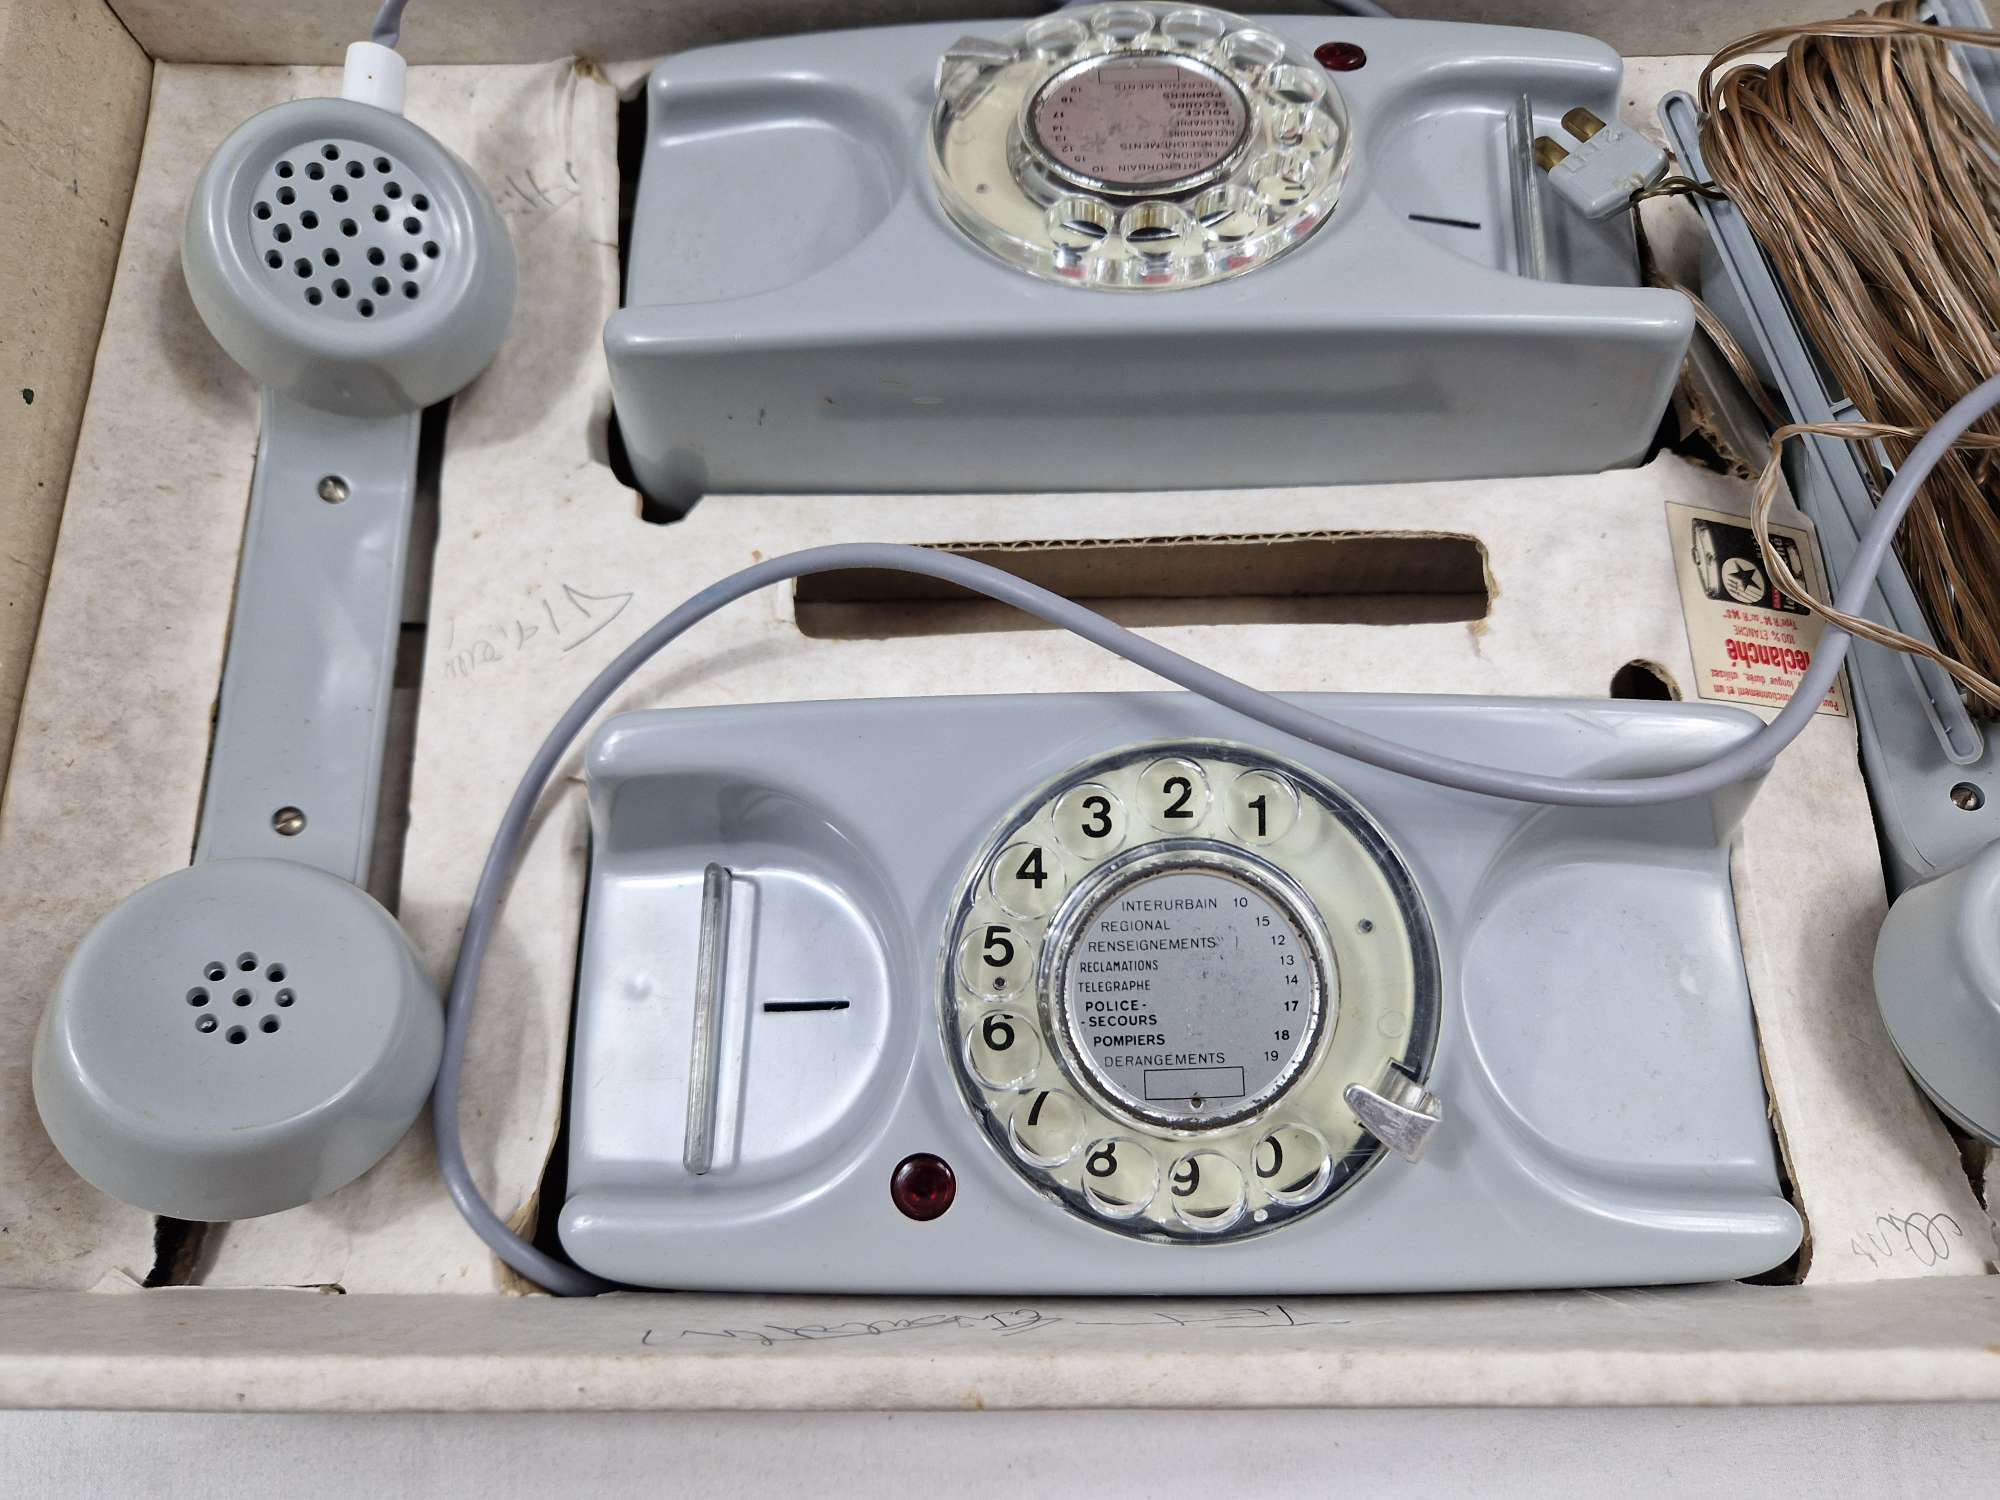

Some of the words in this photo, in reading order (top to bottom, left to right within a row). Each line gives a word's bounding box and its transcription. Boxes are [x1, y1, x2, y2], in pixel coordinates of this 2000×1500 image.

[1163, 777, 1193, 819] 2
[1248, 795, 1267, 836] 1
[1082, 796, 1113, 838] 3
[1016, 847, 1048, 889] 4
[1121, 898, 1218, 912] INTERURBAIN
[1233, 897, 1248, 908] 10
[1101, 919, 1171, 932] REGIONAL
[1255, 916, 1271, 927] 15
[983, 925, 1014, 967] 5
[1088, 936, 1217, 953] RENSEIGNEMENTS
[1271, 935, 1286, 946] 12
[1080, 960, 1159, 973] RECLAMATIONS
[1280, 955, 1295, 965] 13
[1078, 980, 1151, 993] TELEGRAPHE
[1285, 974, 1298, 985] 14
[1284, 1000, 1299, 1012] 17
[982, 1014, 1015, 1051] 6
[1093, 1034, 1166, 1047] POMPIERS
[1274, 1029, 1290, 1041] 18
[1104, 1052, 1226, 1068] DERANGEMENTS
[1264, 1050, 1279, 1062] 19
[1023, 1089, 1050, 1126] 7
[1085, 1142, 1117, 1177] 8
[1256, 1135, 1283, 1178] 0
[1171, 1157, 1200, 1197] 9
